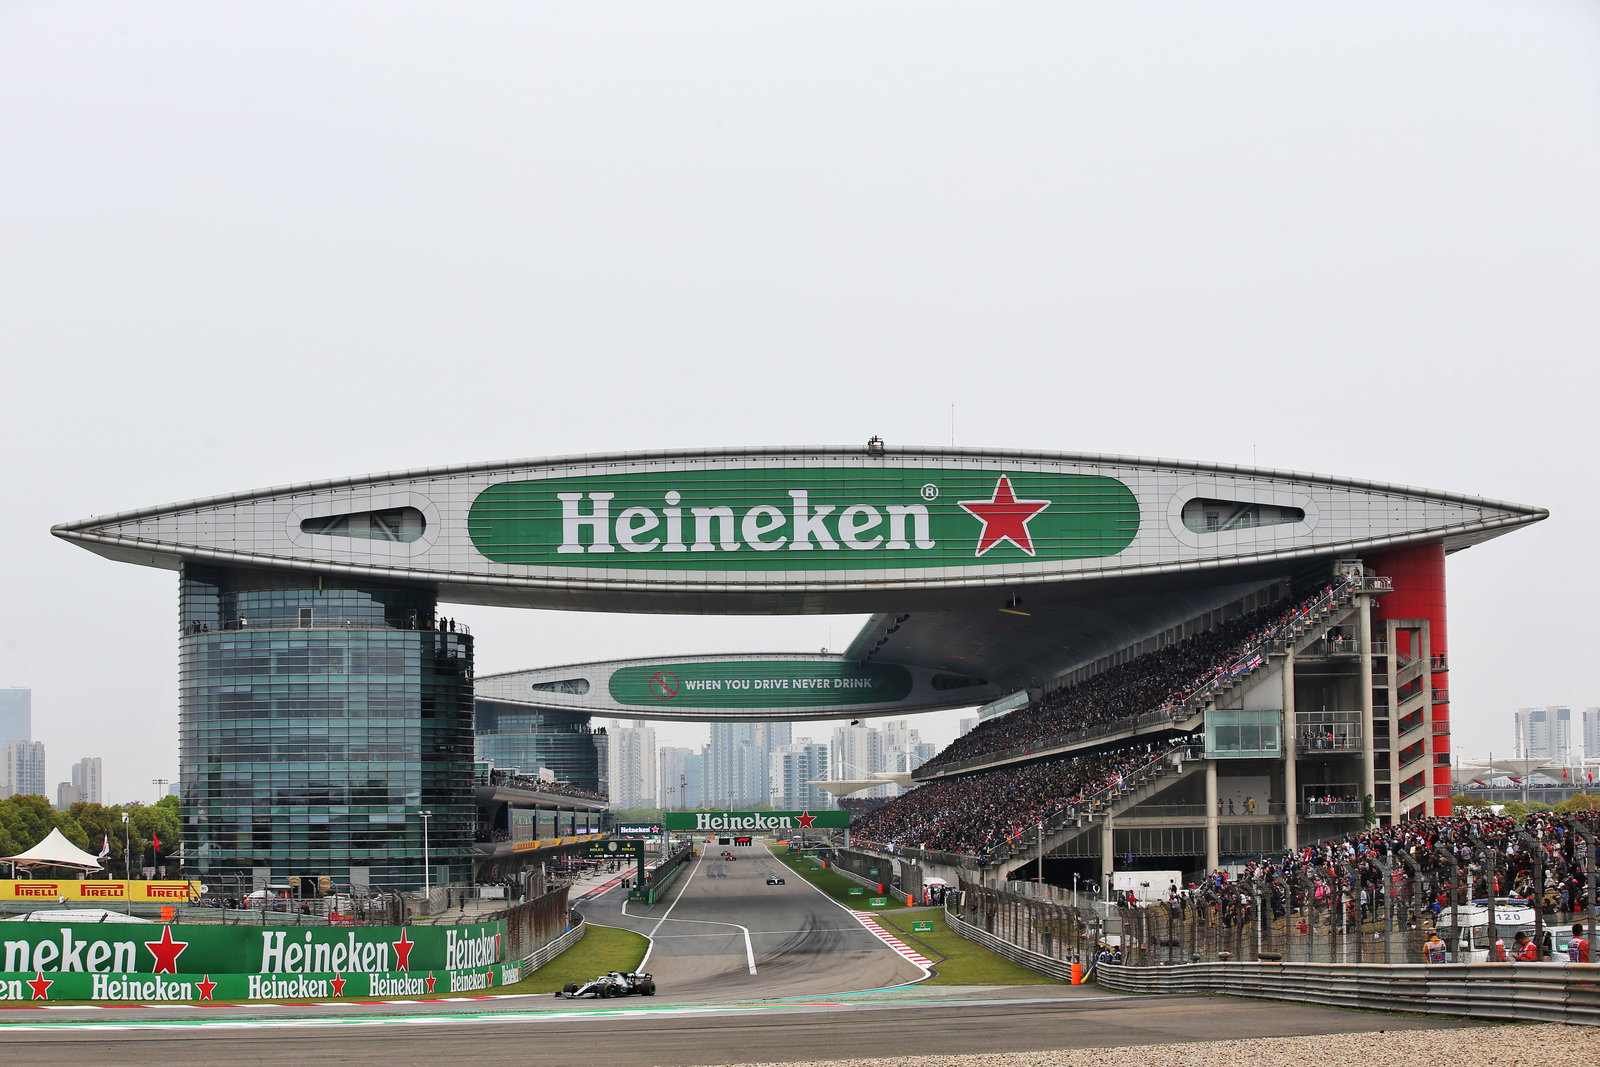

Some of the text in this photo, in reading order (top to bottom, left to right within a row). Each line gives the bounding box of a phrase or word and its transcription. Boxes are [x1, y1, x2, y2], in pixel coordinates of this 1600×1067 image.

[685, 678, 872, 690] WHEN YOU DRIVE NEVER DRINK
[696, 813, 792, 830] Heineken
[15, 884, 58, 897] PIRELLI
[80, 884, 124, 897] PIRELLI
[1496, 913, 1521, 921] 120
[259, 930, 389, 973] Heineken
[445, 928, 495, 970] Heineken
[91, 974, 192, 1000] Heineken
[248, 974, 328, 999] Heineken
[369, 972, 424, 997] Heineken
[450, 968, 486, 992] Heineken
